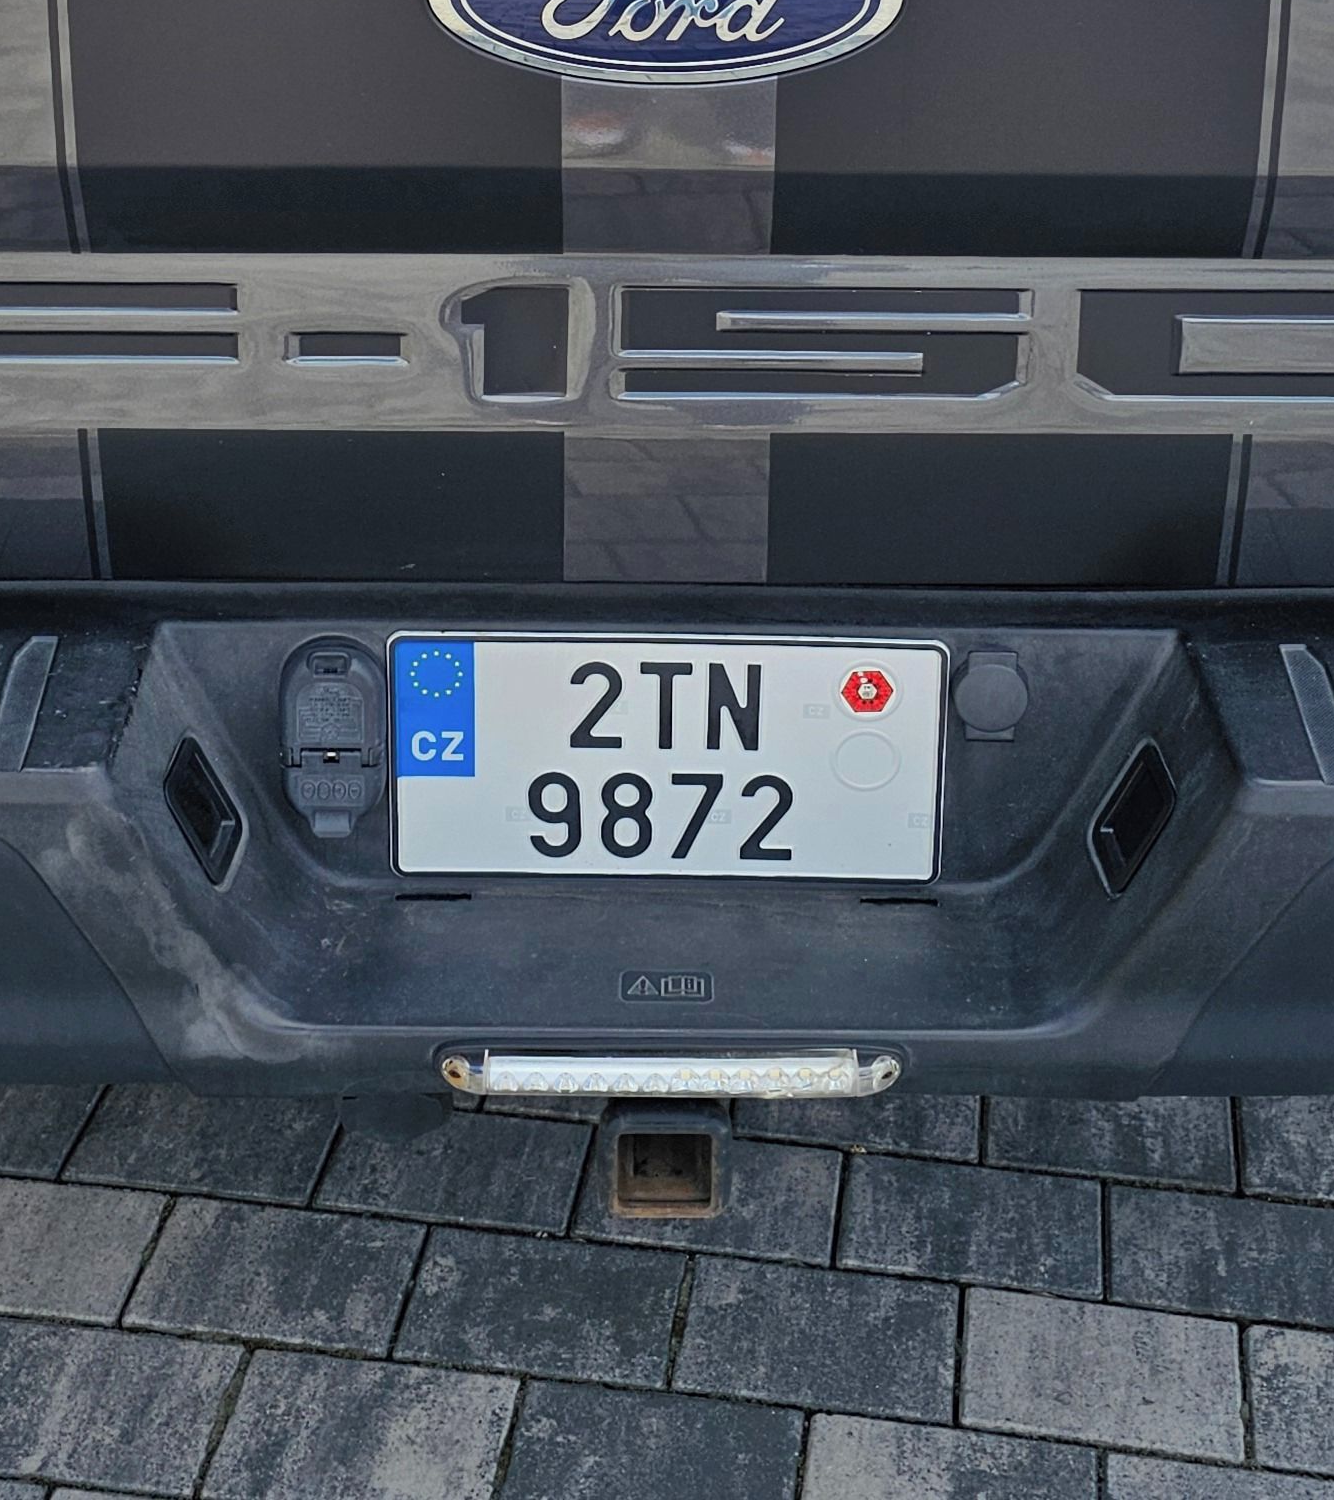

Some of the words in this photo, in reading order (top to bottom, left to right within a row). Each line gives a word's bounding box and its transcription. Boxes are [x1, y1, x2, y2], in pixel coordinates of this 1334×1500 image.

[411, 730, 465, 762] CZ
[569, 660, 762, 751] 2TN
[527, 771, 794, 861] 9872
